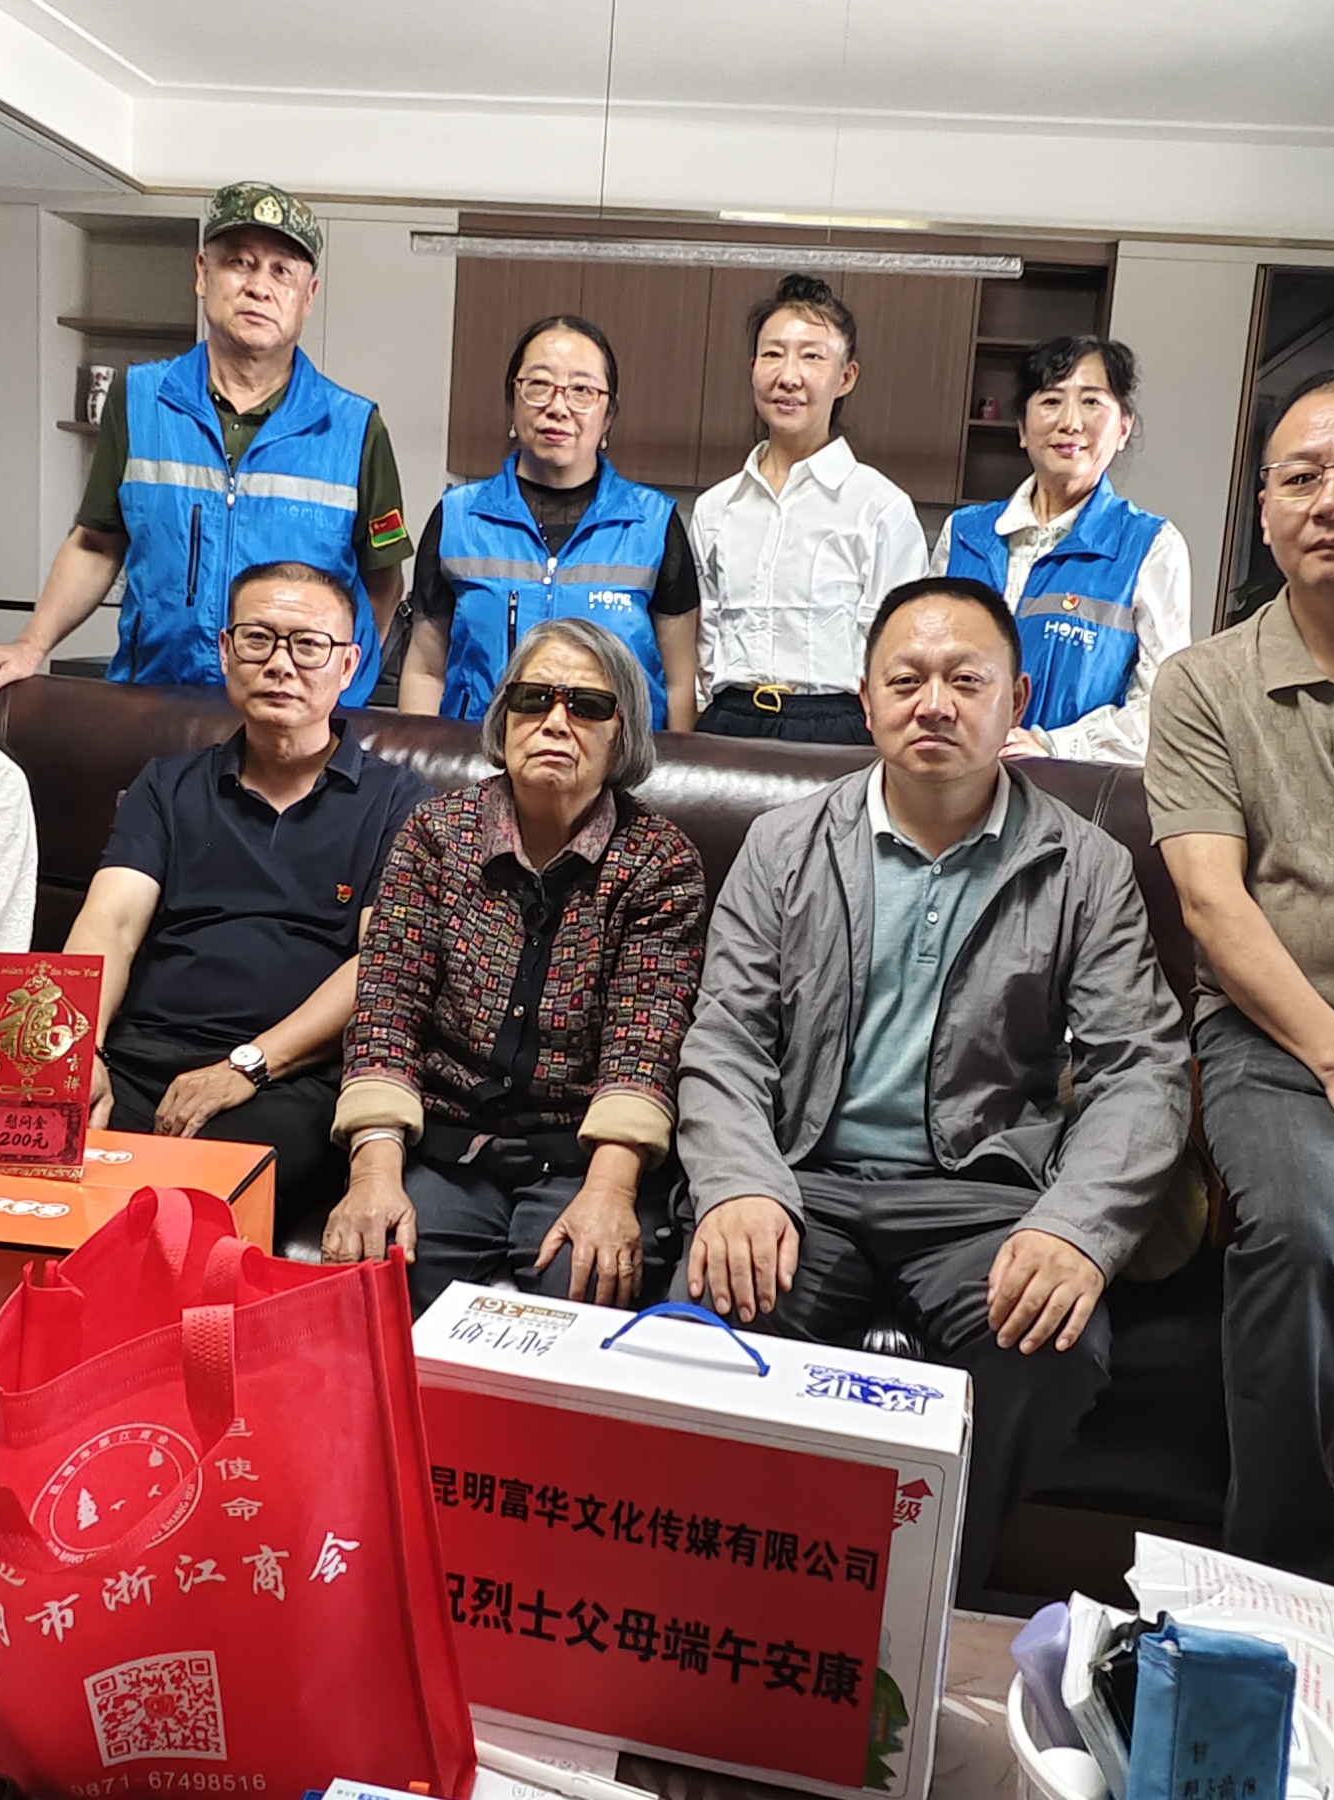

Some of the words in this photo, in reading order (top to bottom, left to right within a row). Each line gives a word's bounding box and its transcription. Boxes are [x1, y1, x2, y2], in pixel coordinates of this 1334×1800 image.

[1043, 620, 1098, 645] HOME
[4, 1113, 49, 1131] 慰问金
[429, 1464, 880, 1592] 昆明富华文化传媒有限公司
